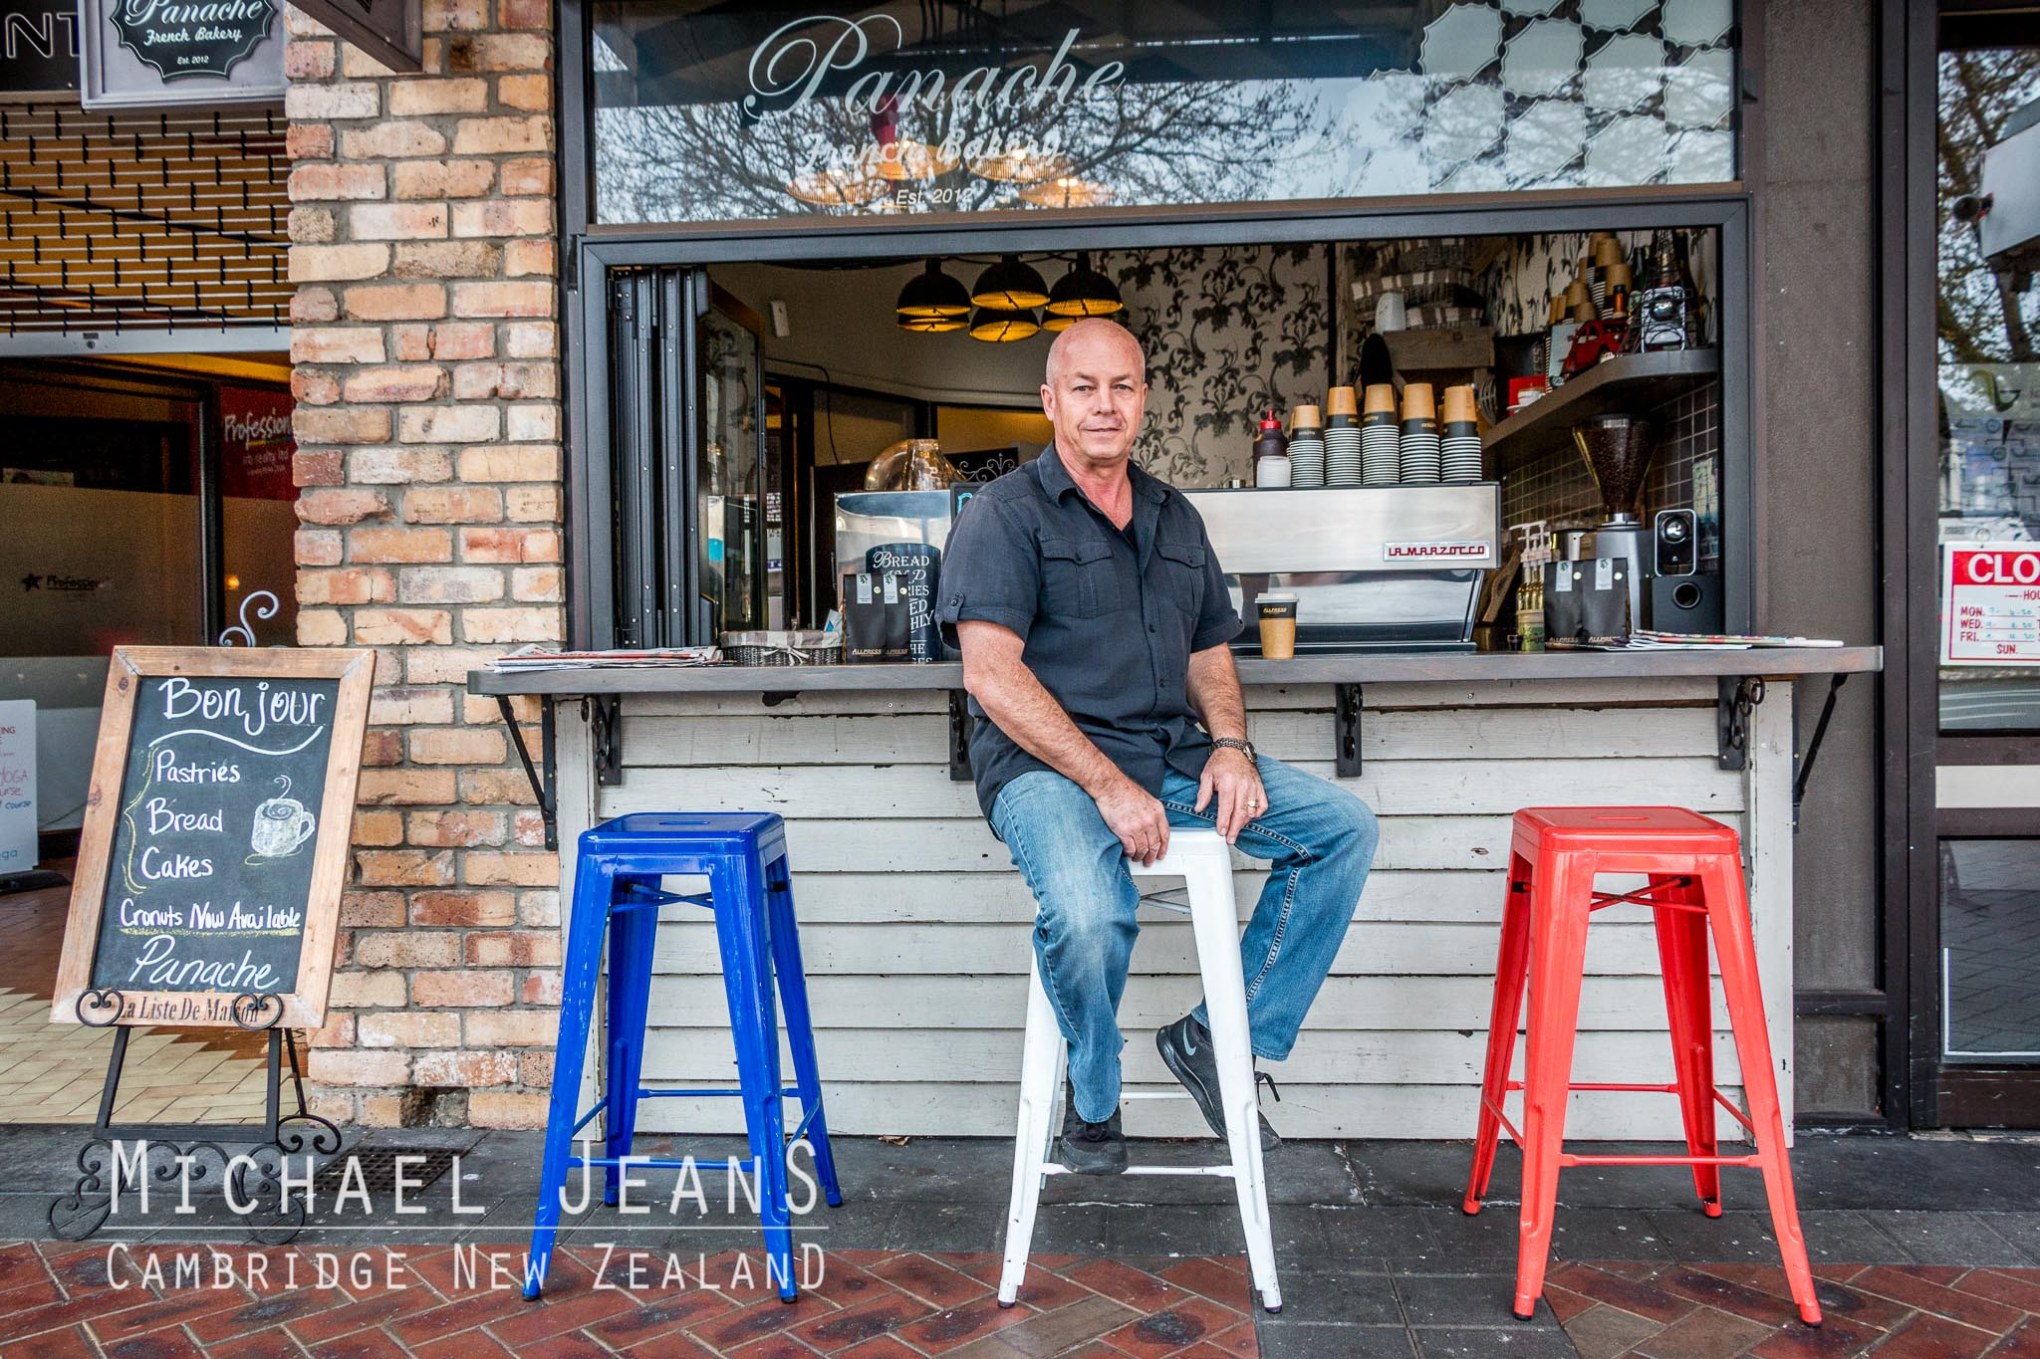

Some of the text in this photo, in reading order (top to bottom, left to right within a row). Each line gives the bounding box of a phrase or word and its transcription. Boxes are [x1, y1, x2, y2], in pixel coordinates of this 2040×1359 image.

[125, 0, 263, 27] Panache
[0, 12, 80, 59] NT
[144, 26, 243, 47] French Bakery
[191, 55, 209, 65] 2012
[742, 13, 1127, 120] Panache
[806, 126, 1067, 171] French Bakery
[932, 187, 974, 204] 2012
[872, 550, 930, 569] BREAD
[852, 648, 882, 656] ALLPRESS
[156, 749, 242, 784] Pastries
[146, 797, 224, 836] Bread
[141, 846, 214, 880] Cakes
[120, 898, 302, 931] Cronuts Now Available
[128, 934, 281, 990] Panache
[139, 996, 177, 1021] Liste
[178, 997, 200, 1022] De
